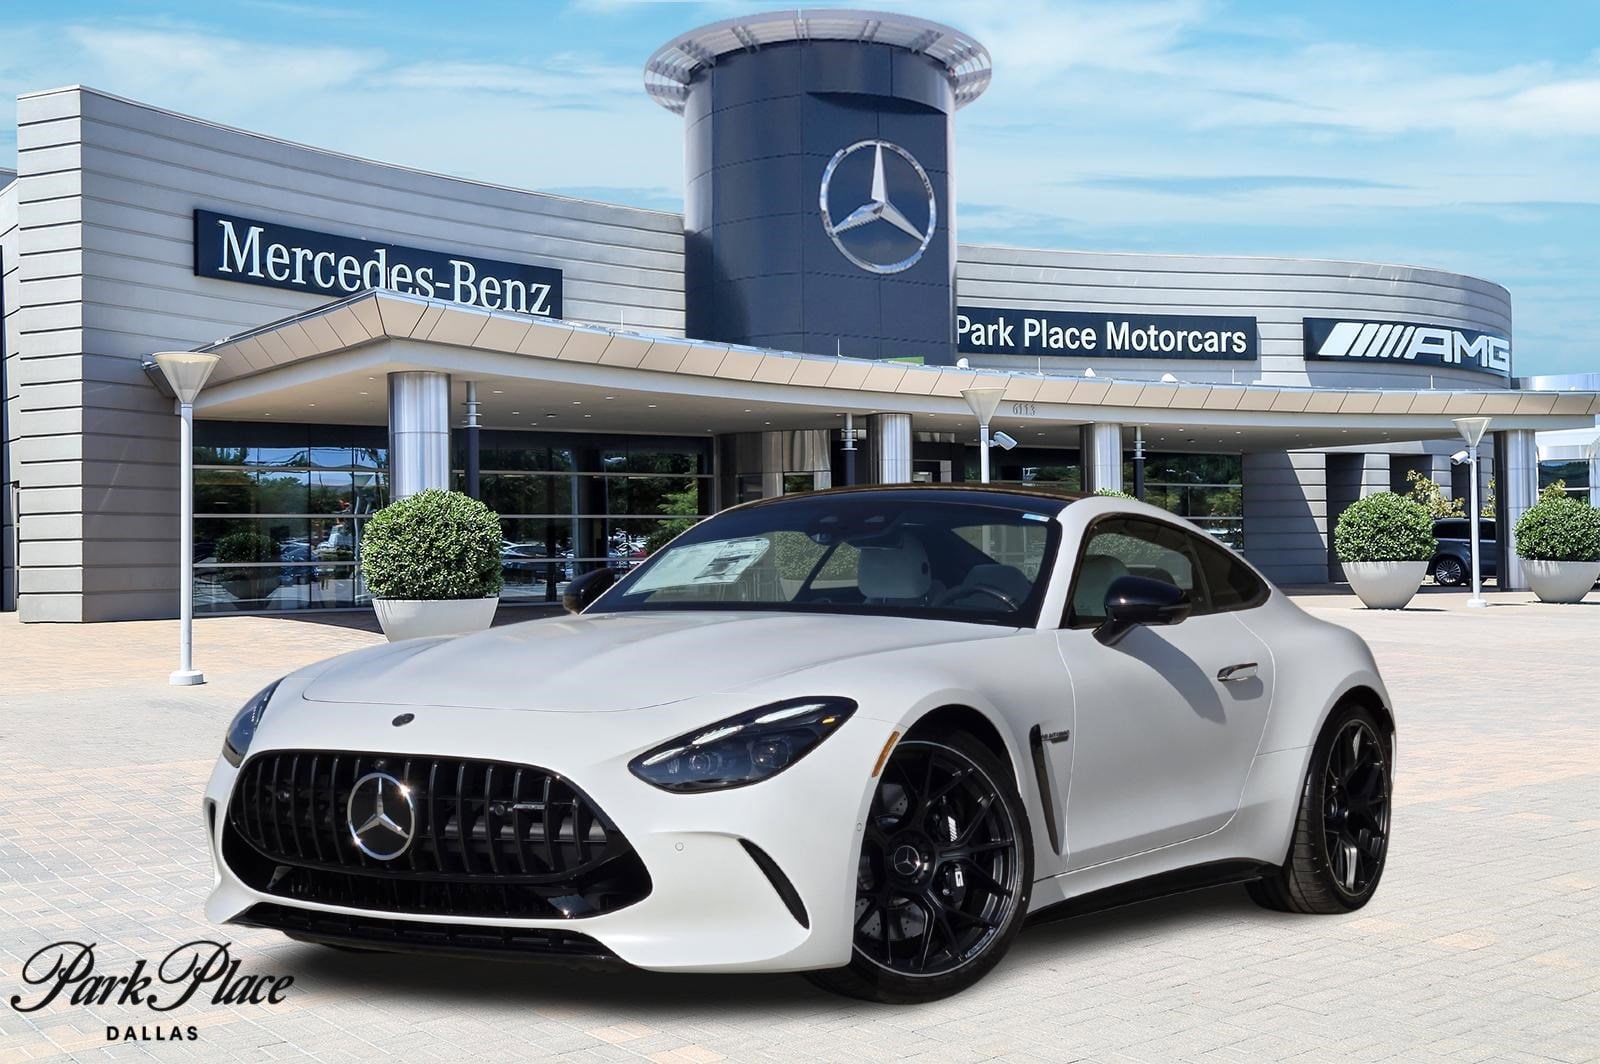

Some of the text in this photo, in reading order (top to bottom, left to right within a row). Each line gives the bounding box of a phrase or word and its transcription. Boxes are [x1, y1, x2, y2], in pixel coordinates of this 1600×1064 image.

[218, 219, 552, 316] Mercedes-Benz
[957, 315, 1248, 353] Park Place Motorcars
[1404, 326, 1510, 371] AMG
[1012, 402, 1036, 416] 6113
